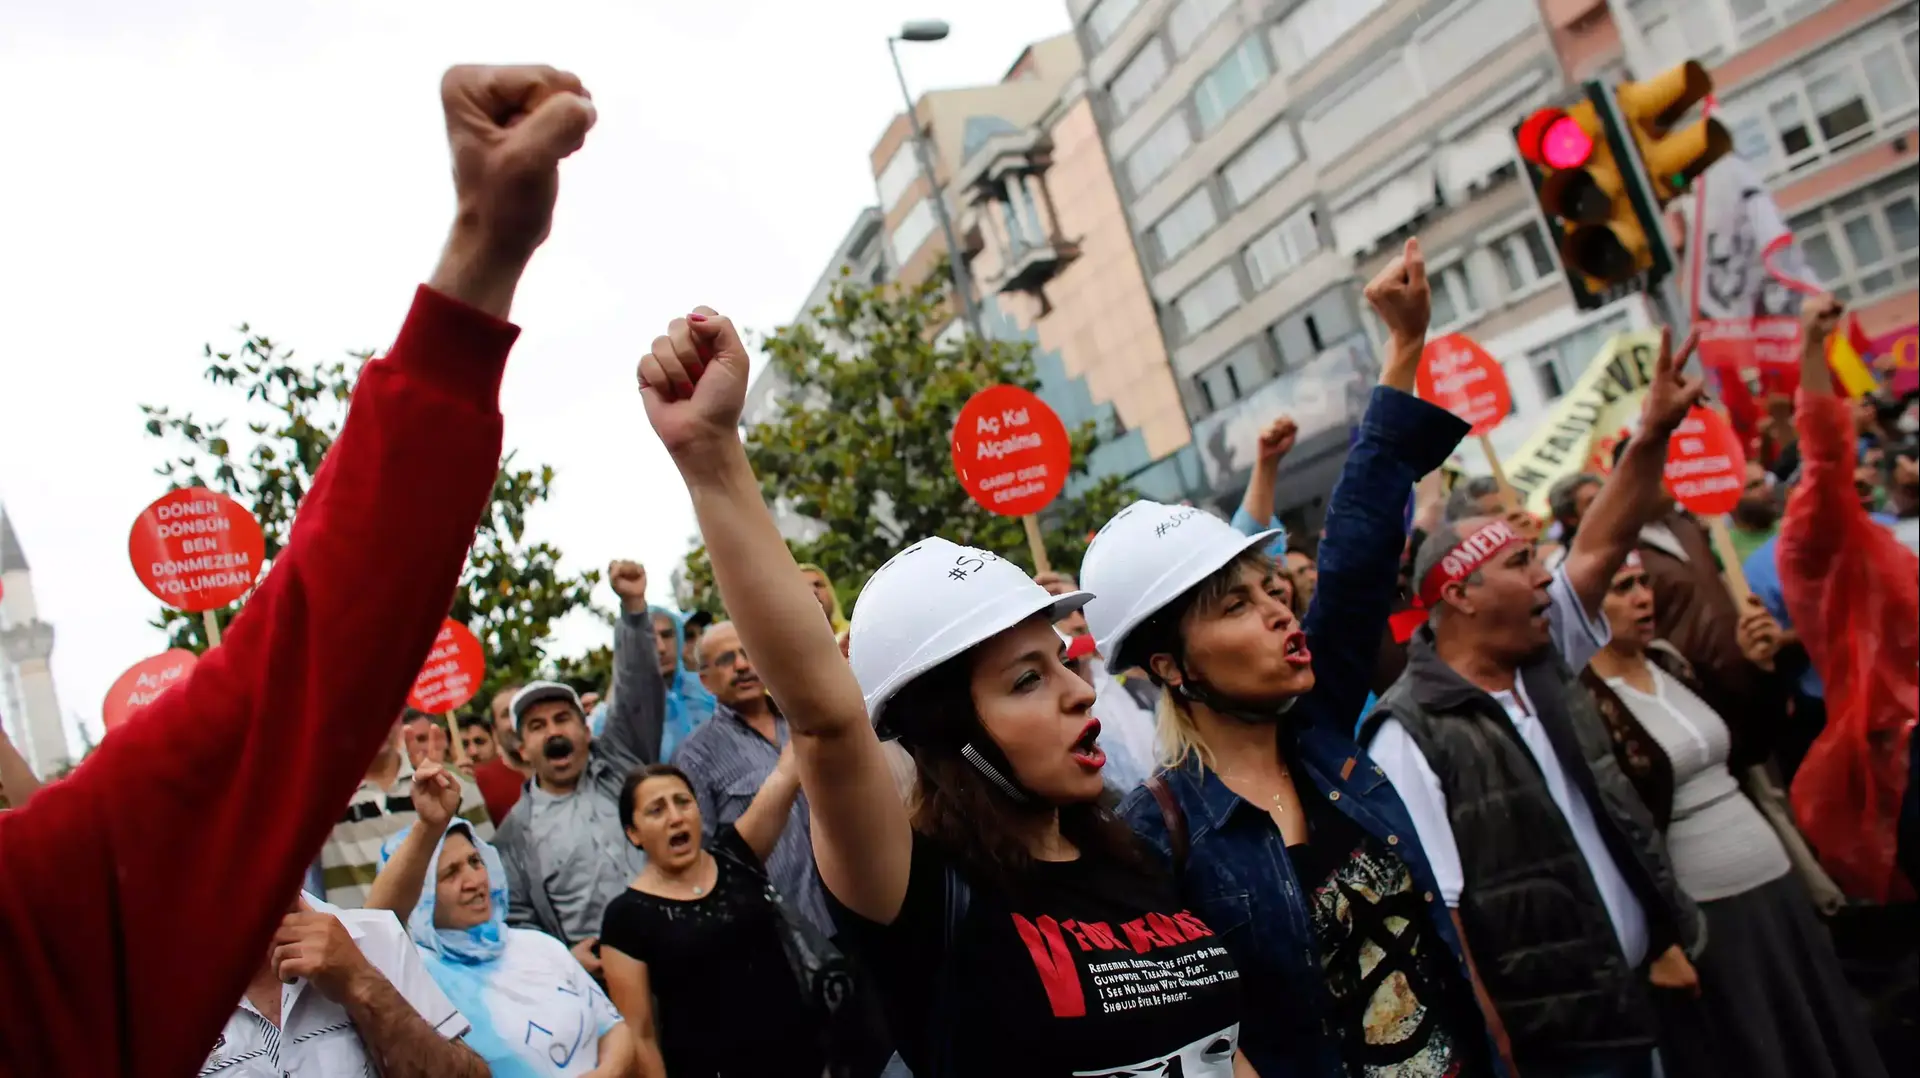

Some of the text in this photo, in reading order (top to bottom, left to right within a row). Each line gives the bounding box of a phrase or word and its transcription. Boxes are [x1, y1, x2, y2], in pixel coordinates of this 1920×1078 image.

[976, 406, 1030, 436] Aç Kal
[976, 432, 1042, 461] Alçalma
[157, 499, 218, 520] DÖNEN
[157, 516, 231, 538] DÖNSÜN
[182, 537, 218, 554] BEN
[151, 551, 249, 577] DÖNMEZEM
[155, 570, 251, 595] YOLUMDAN
[1010, 912, 1086, 1017] V
[1060, 918, 1131, 951] FOR
[1176, 953, 1197, 966] FIFTY
